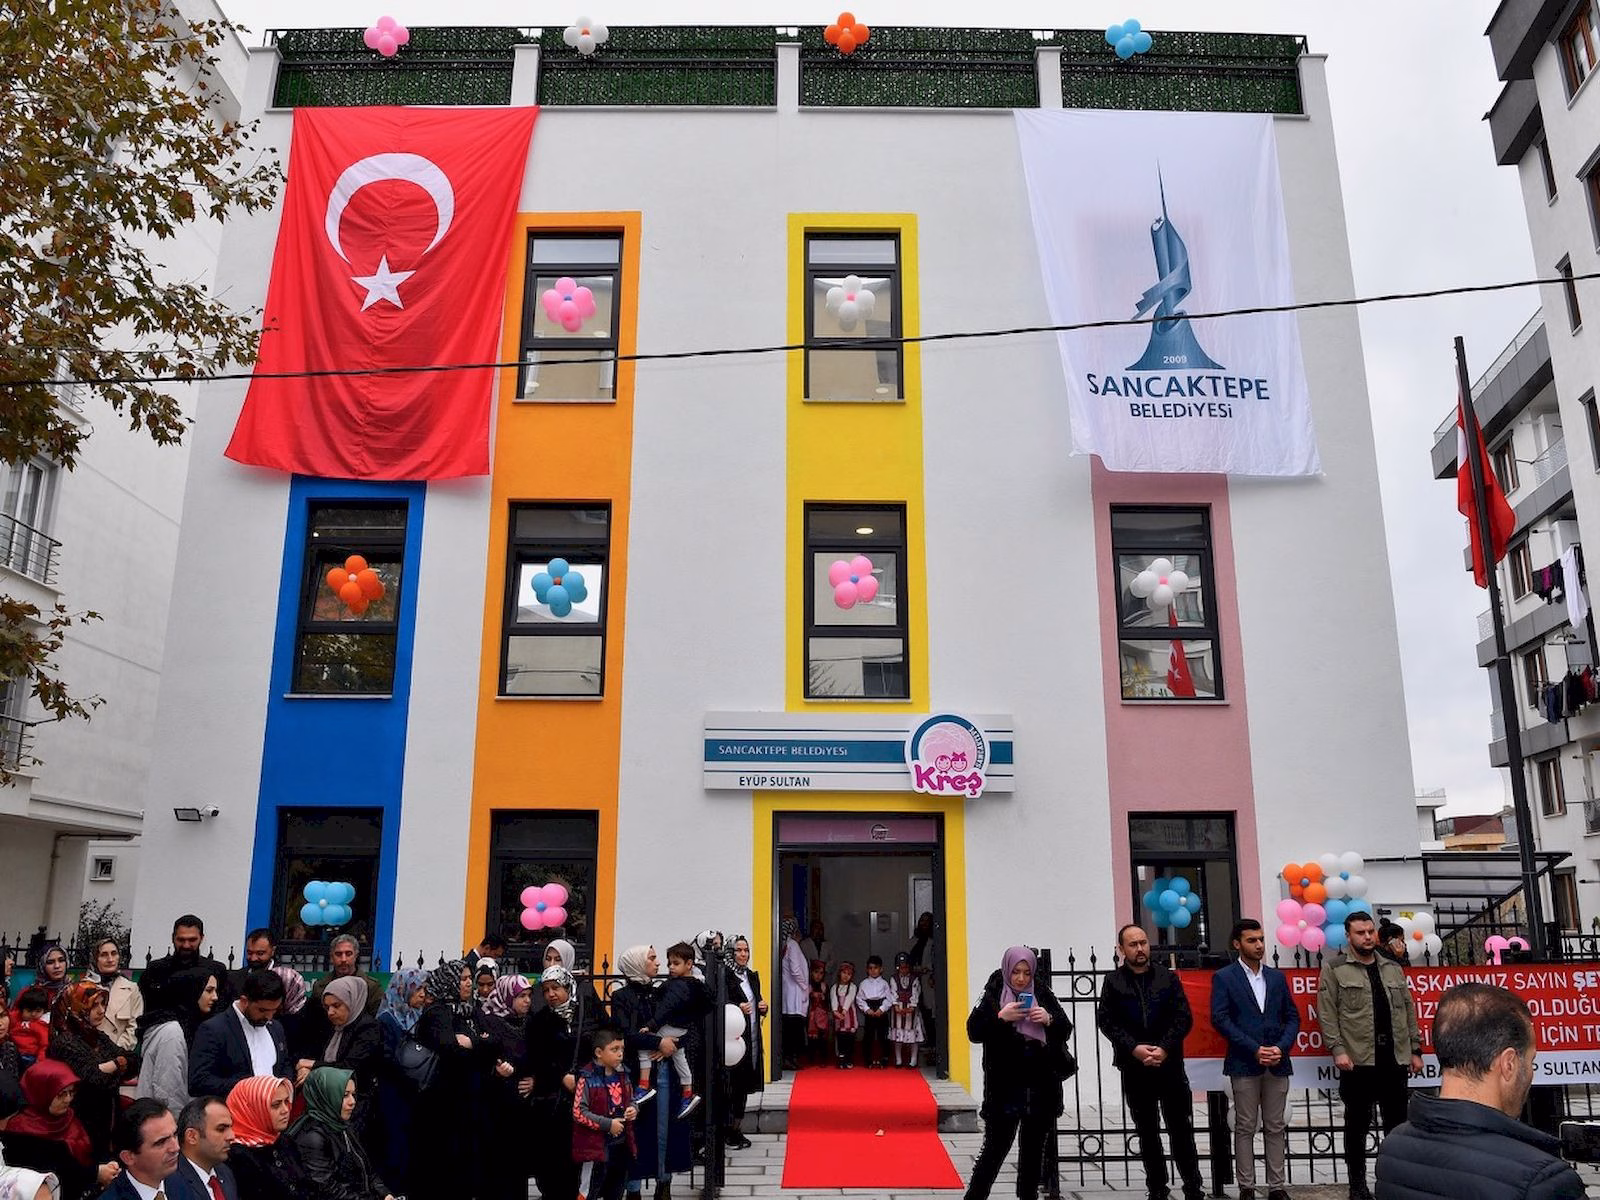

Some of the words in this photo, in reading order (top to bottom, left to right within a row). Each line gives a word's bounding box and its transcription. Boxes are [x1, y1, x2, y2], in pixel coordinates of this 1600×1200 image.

[1086, 373, 1270, 400] SANCAKTEPE
[719, 744, 788, 755] SANCAKTEPE
[739, 775, 768, 787] EYÜP
[770, 776, 811, 787] SULTAN
[914, 764, 982, 796] Kreş
[1406, 973, 1509, 995] AŞKANIMIZ
[1514, 972, 1568, 990] SAYIN
[1572, 970, 1600, 992] ŞE
[1540, 1021, 1579, 1046] İÇİN
[1544, 1061, 1600, 1076] SULTAN
